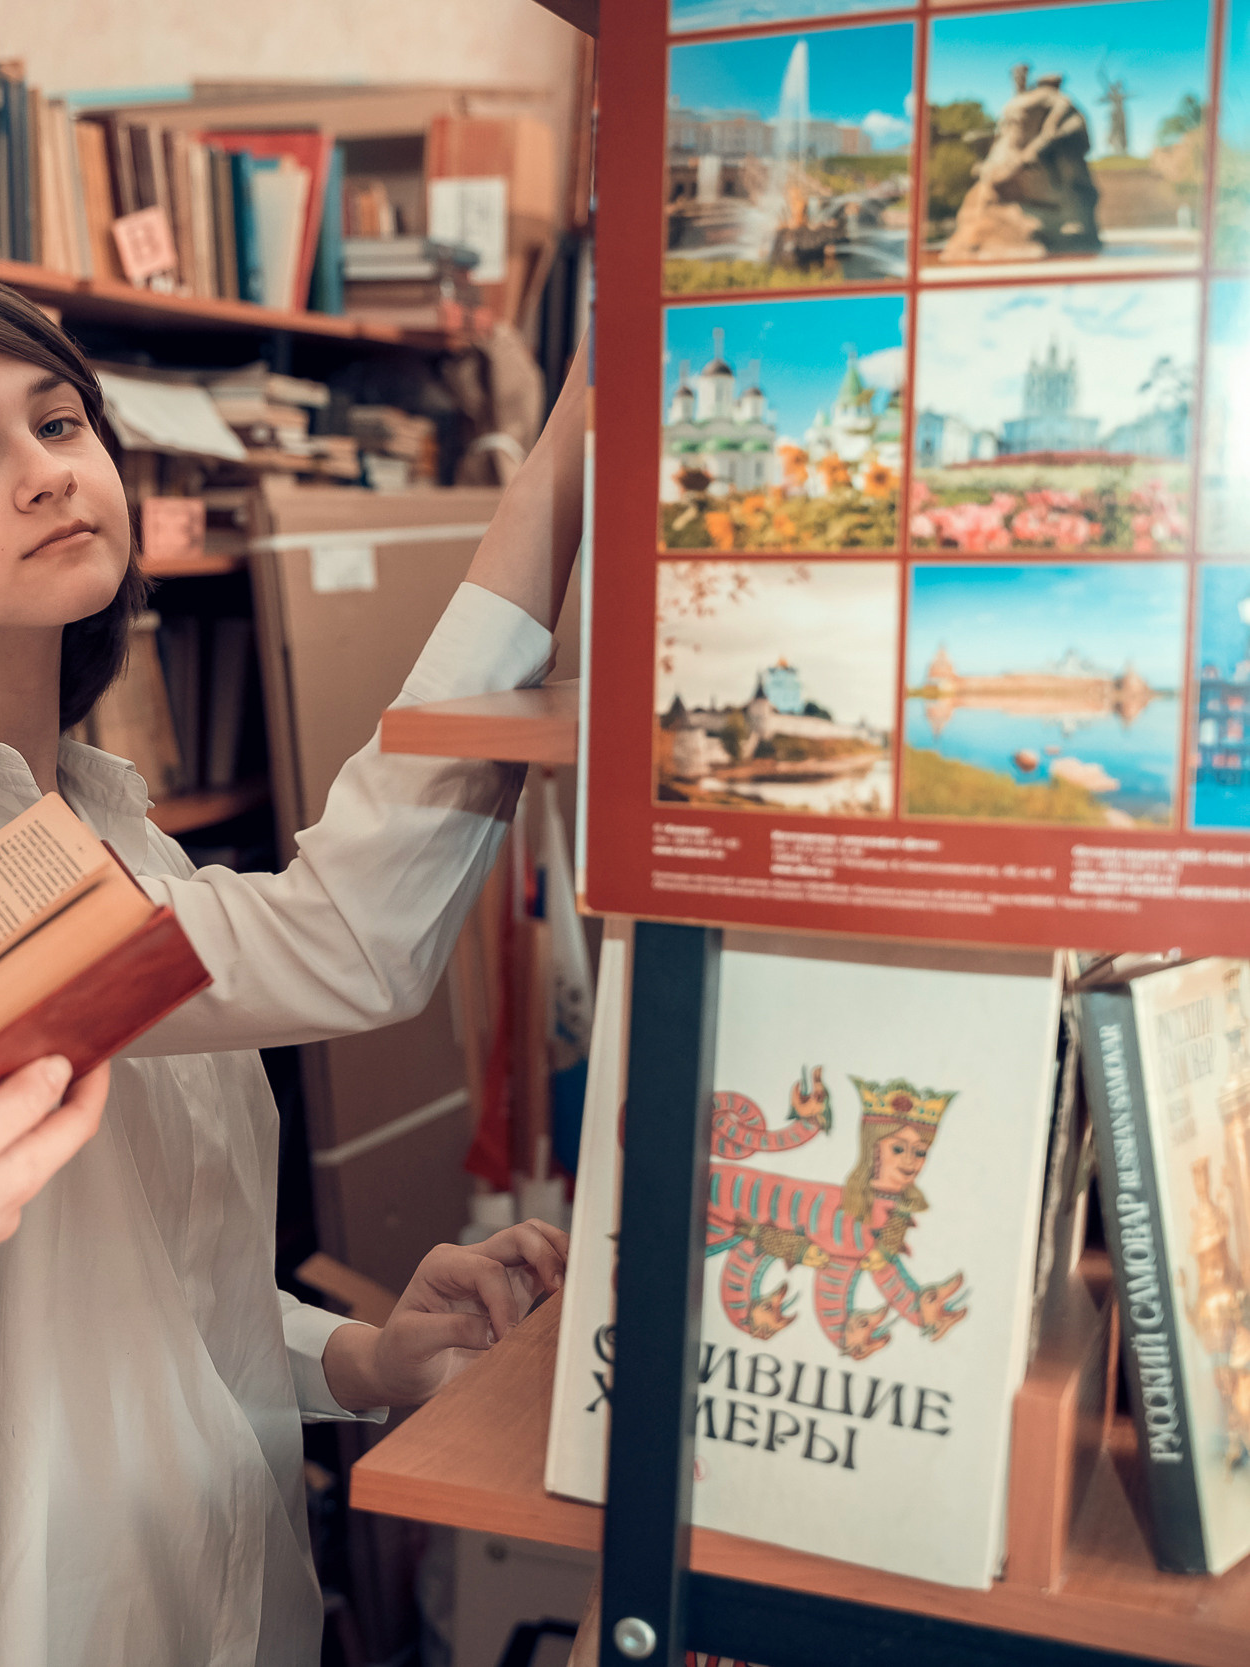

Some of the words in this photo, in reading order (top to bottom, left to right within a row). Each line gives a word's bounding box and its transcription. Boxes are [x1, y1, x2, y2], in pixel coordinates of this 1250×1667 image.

[1098, 1022, 1128, 1111] SAMOVAR
[1109, 1114, 1144, 1191] RUSSIAN
[1115, 1193, 1163, 1328] САМОВАР
[583, 1369, 859, 1472] ХЕРЫ
[593, 1323, 953, 1437] ОИВШИЕ
[1130, 1331, 1184, 1465] РУССКИЙ
